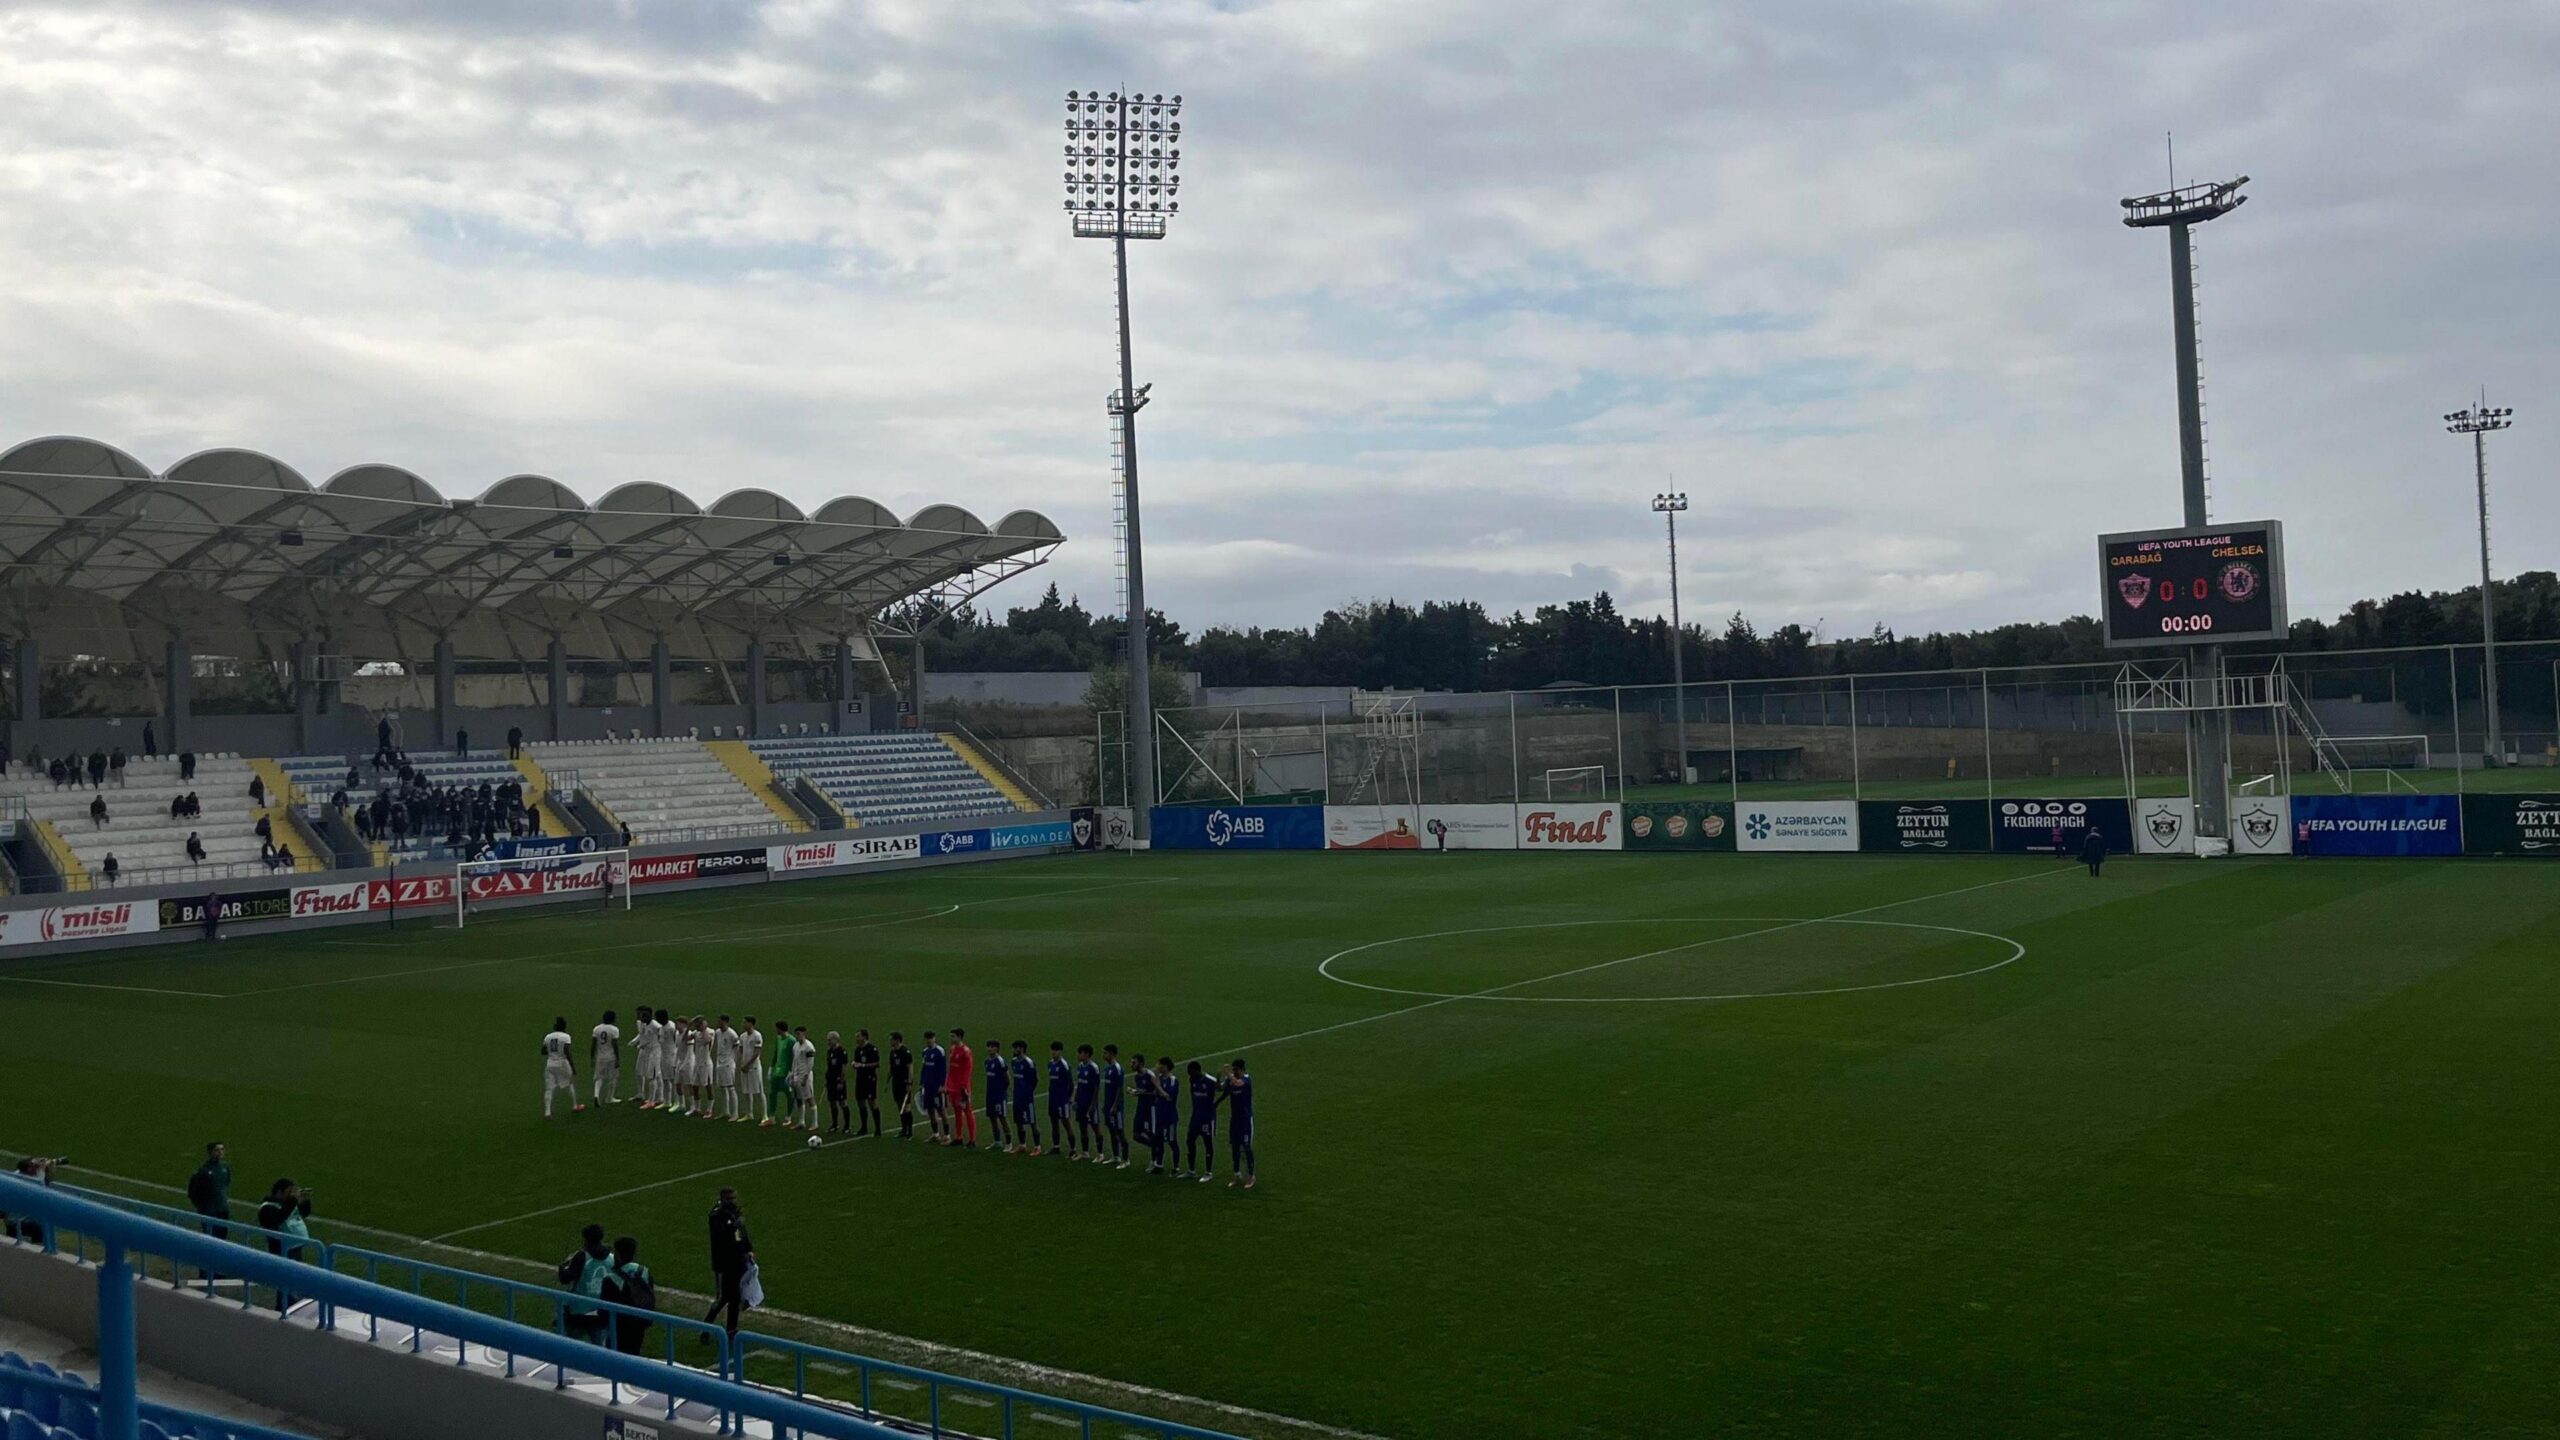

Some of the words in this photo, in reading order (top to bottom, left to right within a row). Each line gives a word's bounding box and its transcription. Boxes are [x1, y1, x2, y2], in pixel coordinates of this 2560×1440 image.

[2137, 540, 2161, 552] UEFA
[2162, 537, 2192, 550] YOUTH
[2194, 535, 2231, 547] LEAGUE
[2212, 545, 2264, 558] CHELSEA
[2111, 552, 2162, 566] QARABAĞ
[2159, 580, 2175, 602] 0
[2192, 577, 2209, 600] 0
[2161, 614, 2212, 633] 00:00
[1233, 817, 1265, 833] ABB
[1525, 810, 1614, 843] Final
[1775, 816, 1846, 825] AZƏRBAYCAN
[1896, 815, 1950, 827] ZEYTUN
[2338, 819, 2388, 832] YOUTH
[2391, 819, 2448, 831] LEAGUE
[955, 834, 974, 845] ABB
[1014, 834, 1046, 845] BONA
[1776, 828, 1809, 837] SƏNAYE
[1903, 829, 1945, 838] BAĞLARI
[796, 843, 836, 861] misli
[852, 838, 918, 855] SİRAB
[646, 860, 695, 876] MARKET
[697, 856, 743, 868] FERRO
[546, 864, 606, 891] Final
[294, 884, 366, 914] Final
[62, 903, 132, 928] misli
[183, 897, 289, 921] BAARSTORE
[601, 1031, 608, 1045] 9
